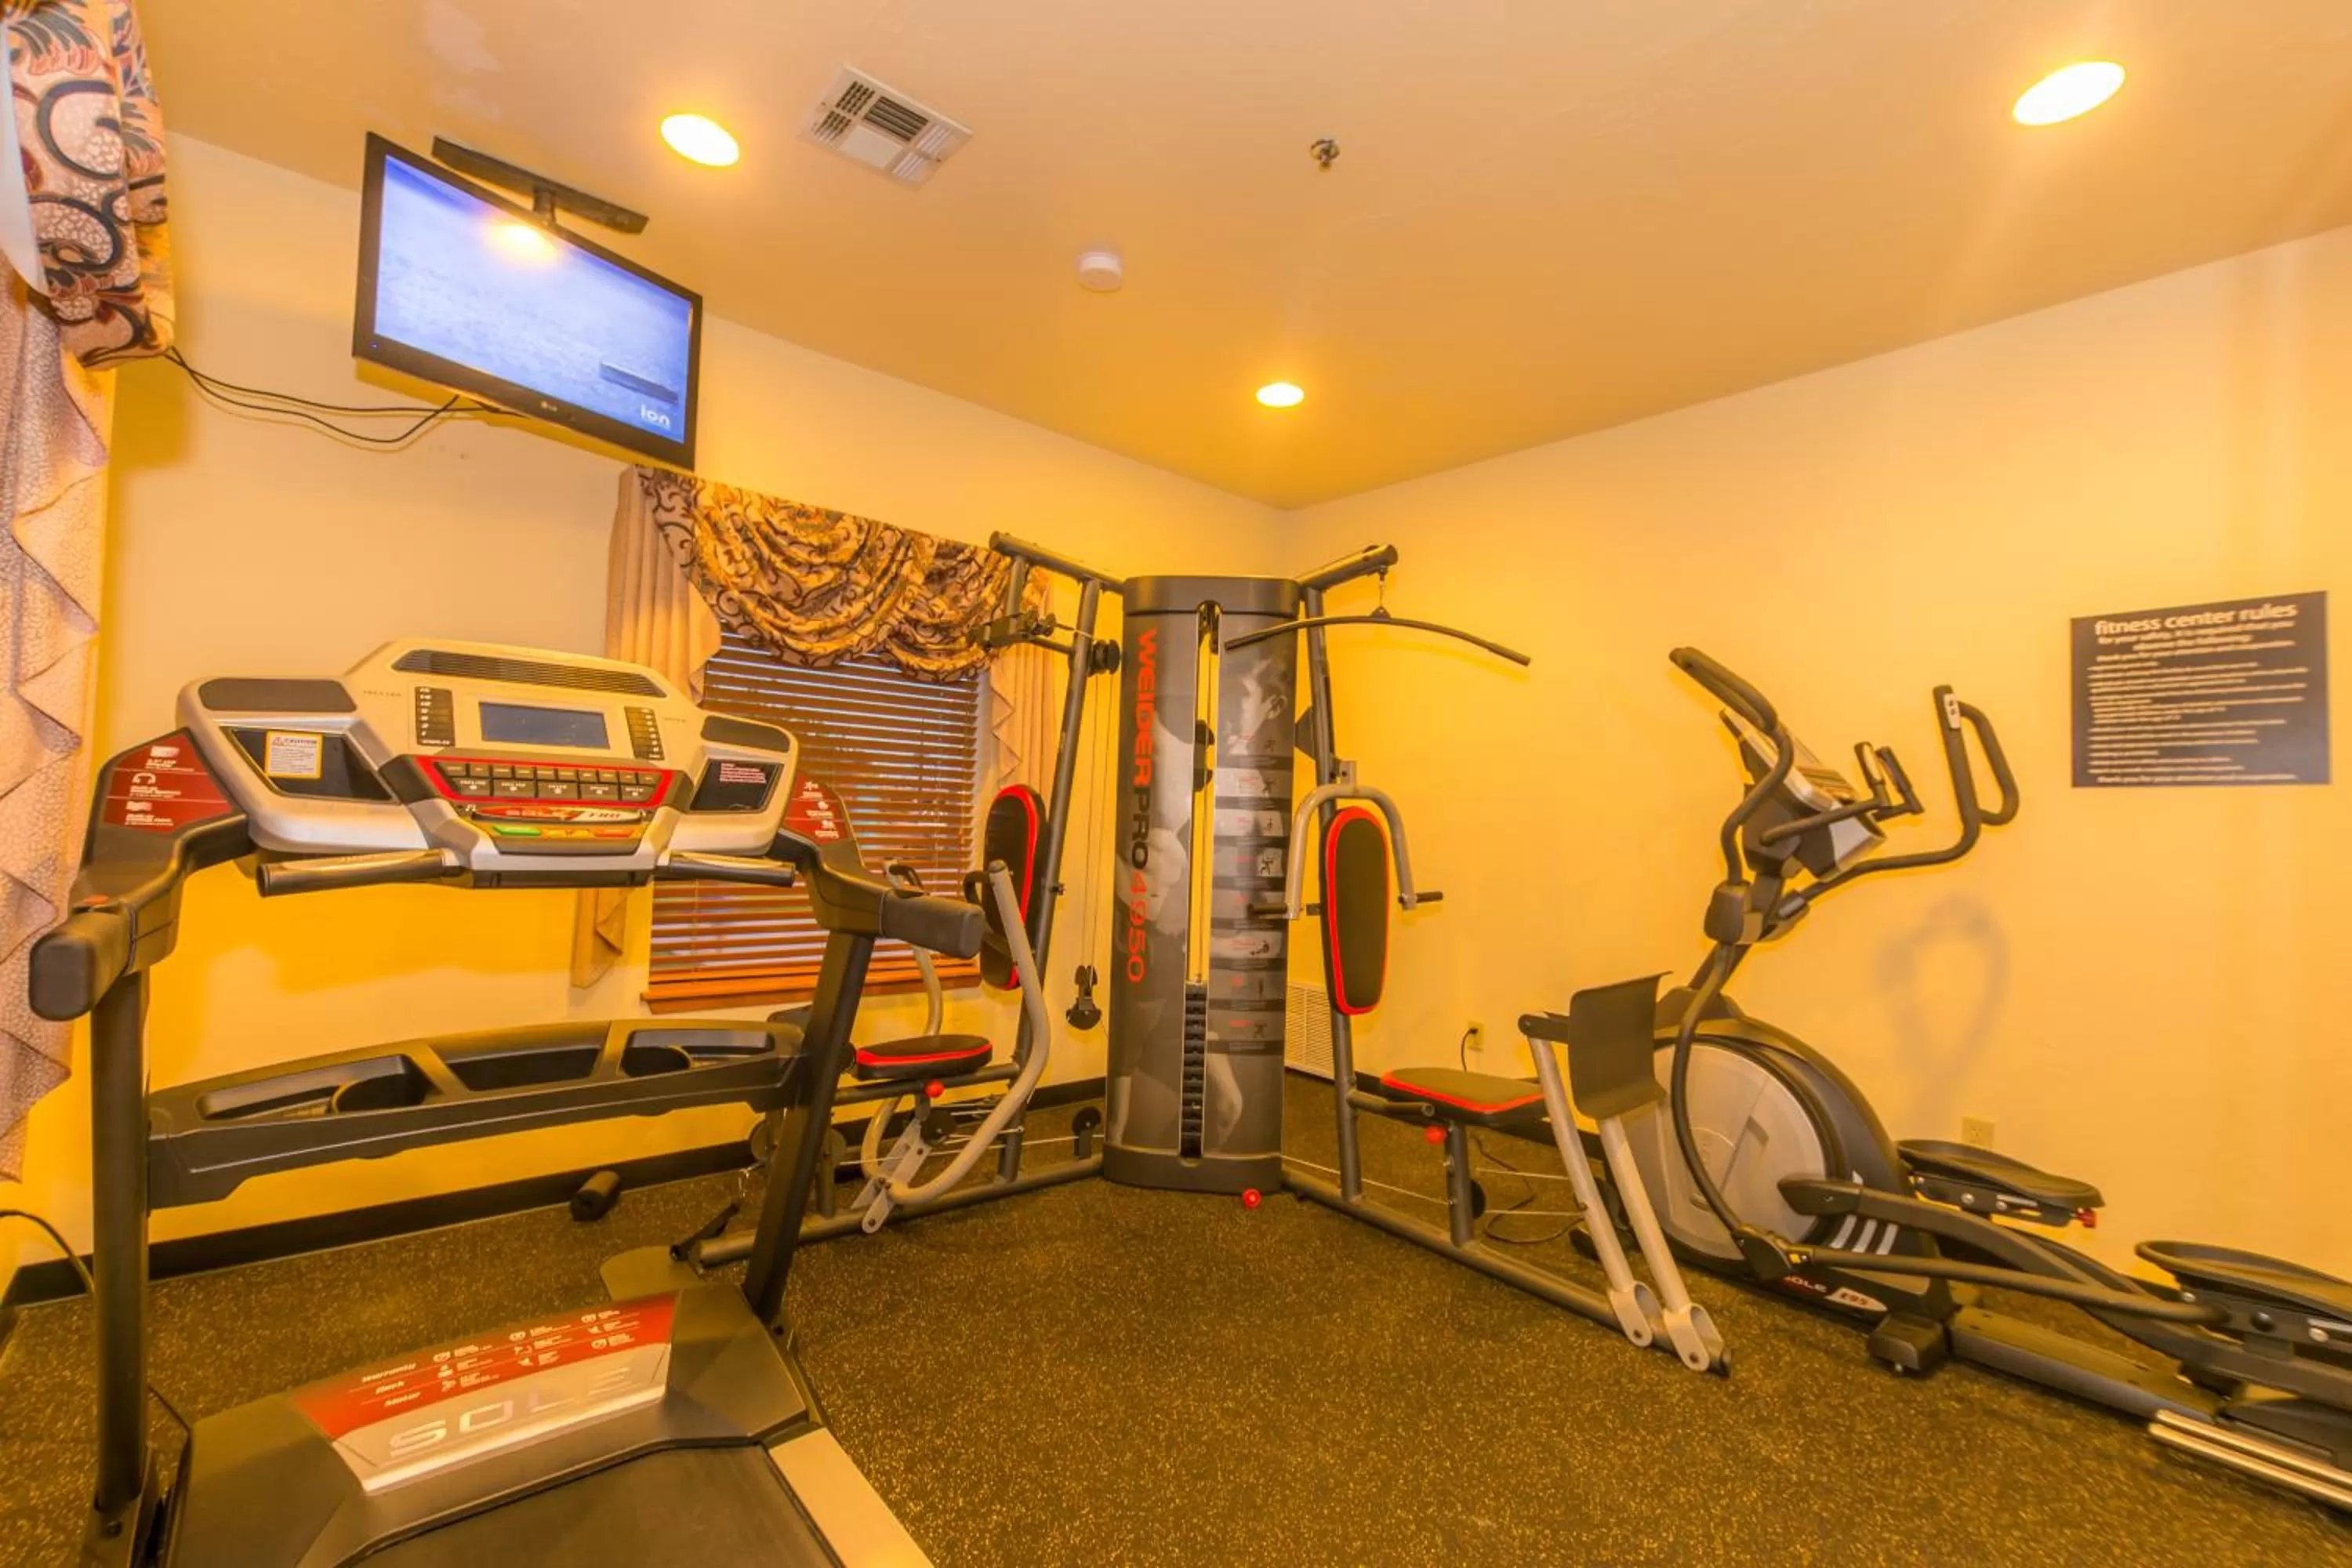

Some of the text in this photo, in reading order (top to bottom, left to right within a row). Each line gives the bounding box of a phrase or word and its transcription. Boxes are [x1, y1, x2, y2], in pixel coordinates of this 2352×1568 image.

[2094, 619, 2161, 636] fitness
[2164, 610, 2236, 629] center
[2238, 602, 2299, 622] rules
[1127, 627, 1156, 982] WEIDER PRO 4950
[390, 1367, 637, 1457] SOLE
